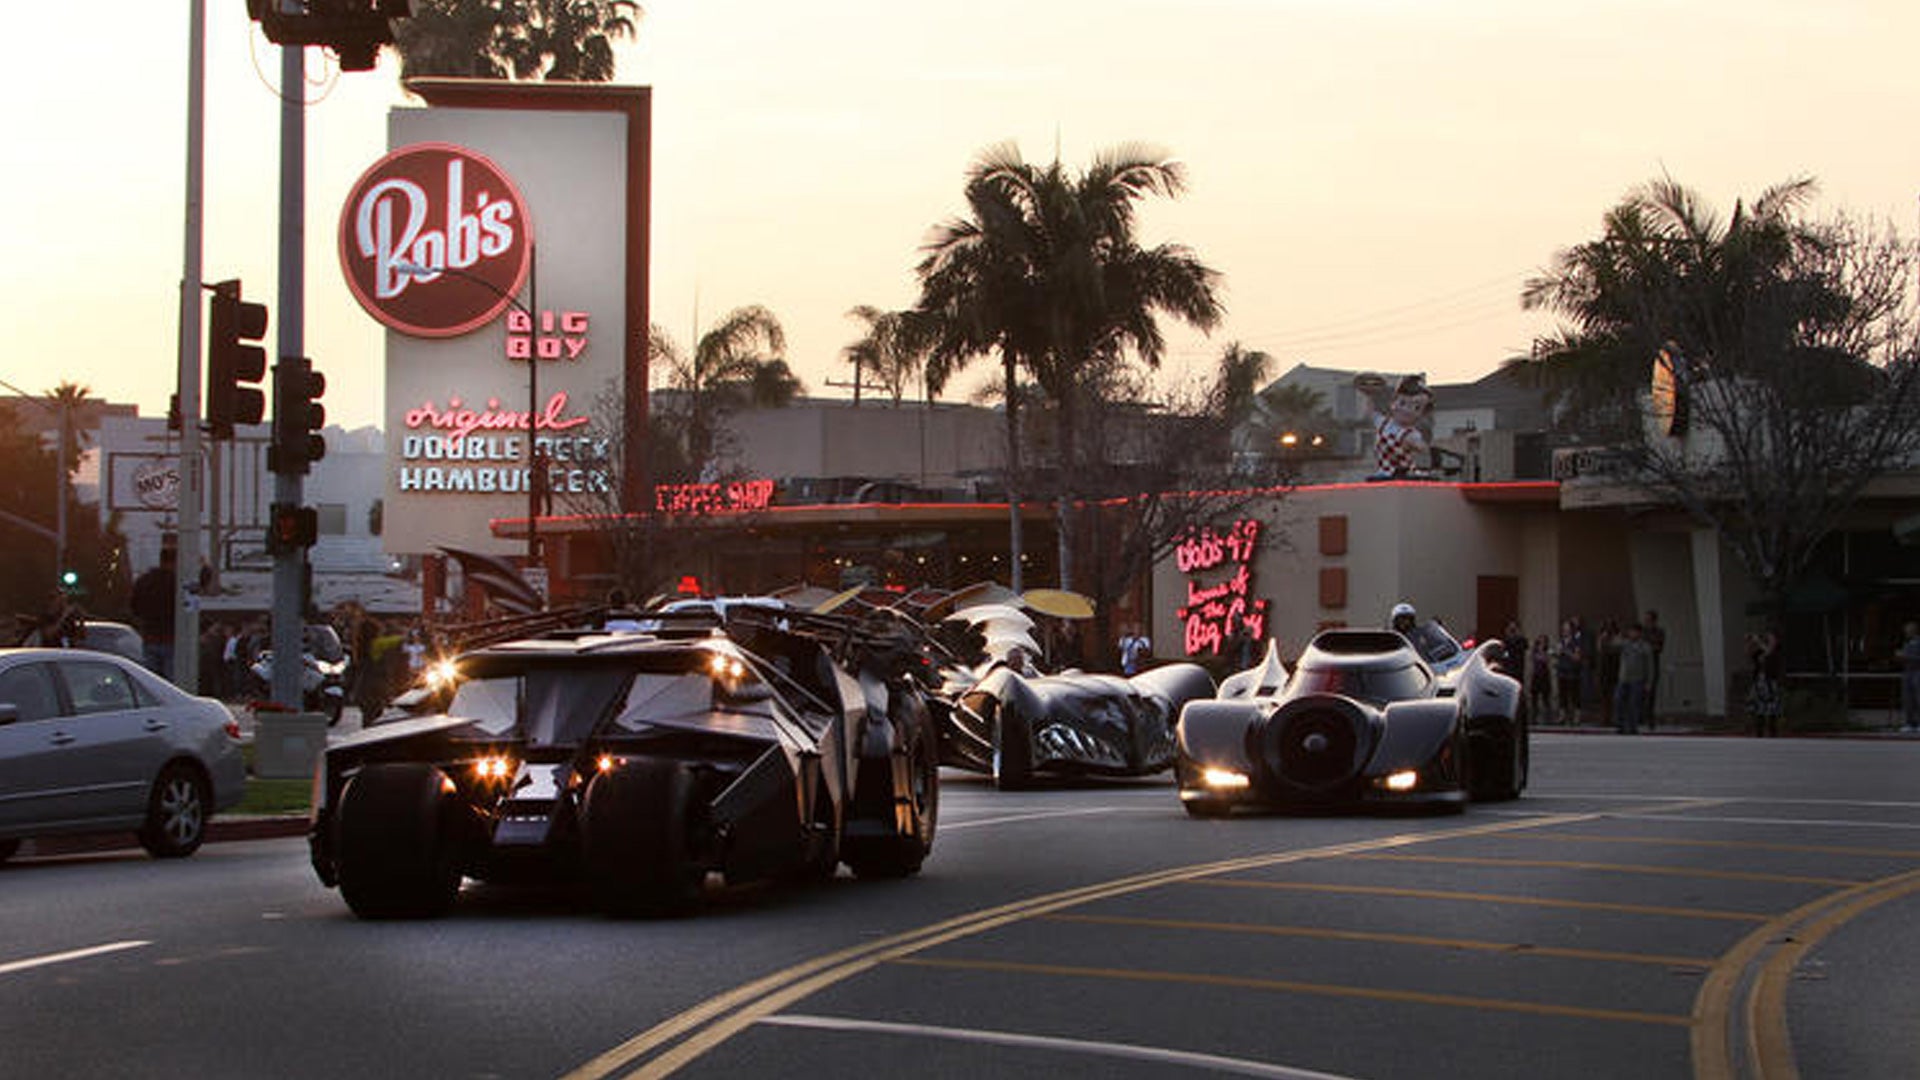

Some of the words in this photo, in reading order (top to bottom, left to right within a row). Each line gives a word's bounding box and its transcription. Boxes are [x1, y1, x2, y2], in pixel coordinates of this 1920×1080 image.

[356, 158, 514, 299] Bob's
[507, 310, 591, 333] BIG
[506, 336, 589, 359] BOY
[405, 391, 589, 451] original
[403, 436, 521, 460] DOUBLE
[727, 480, 775, 512] SHOP
